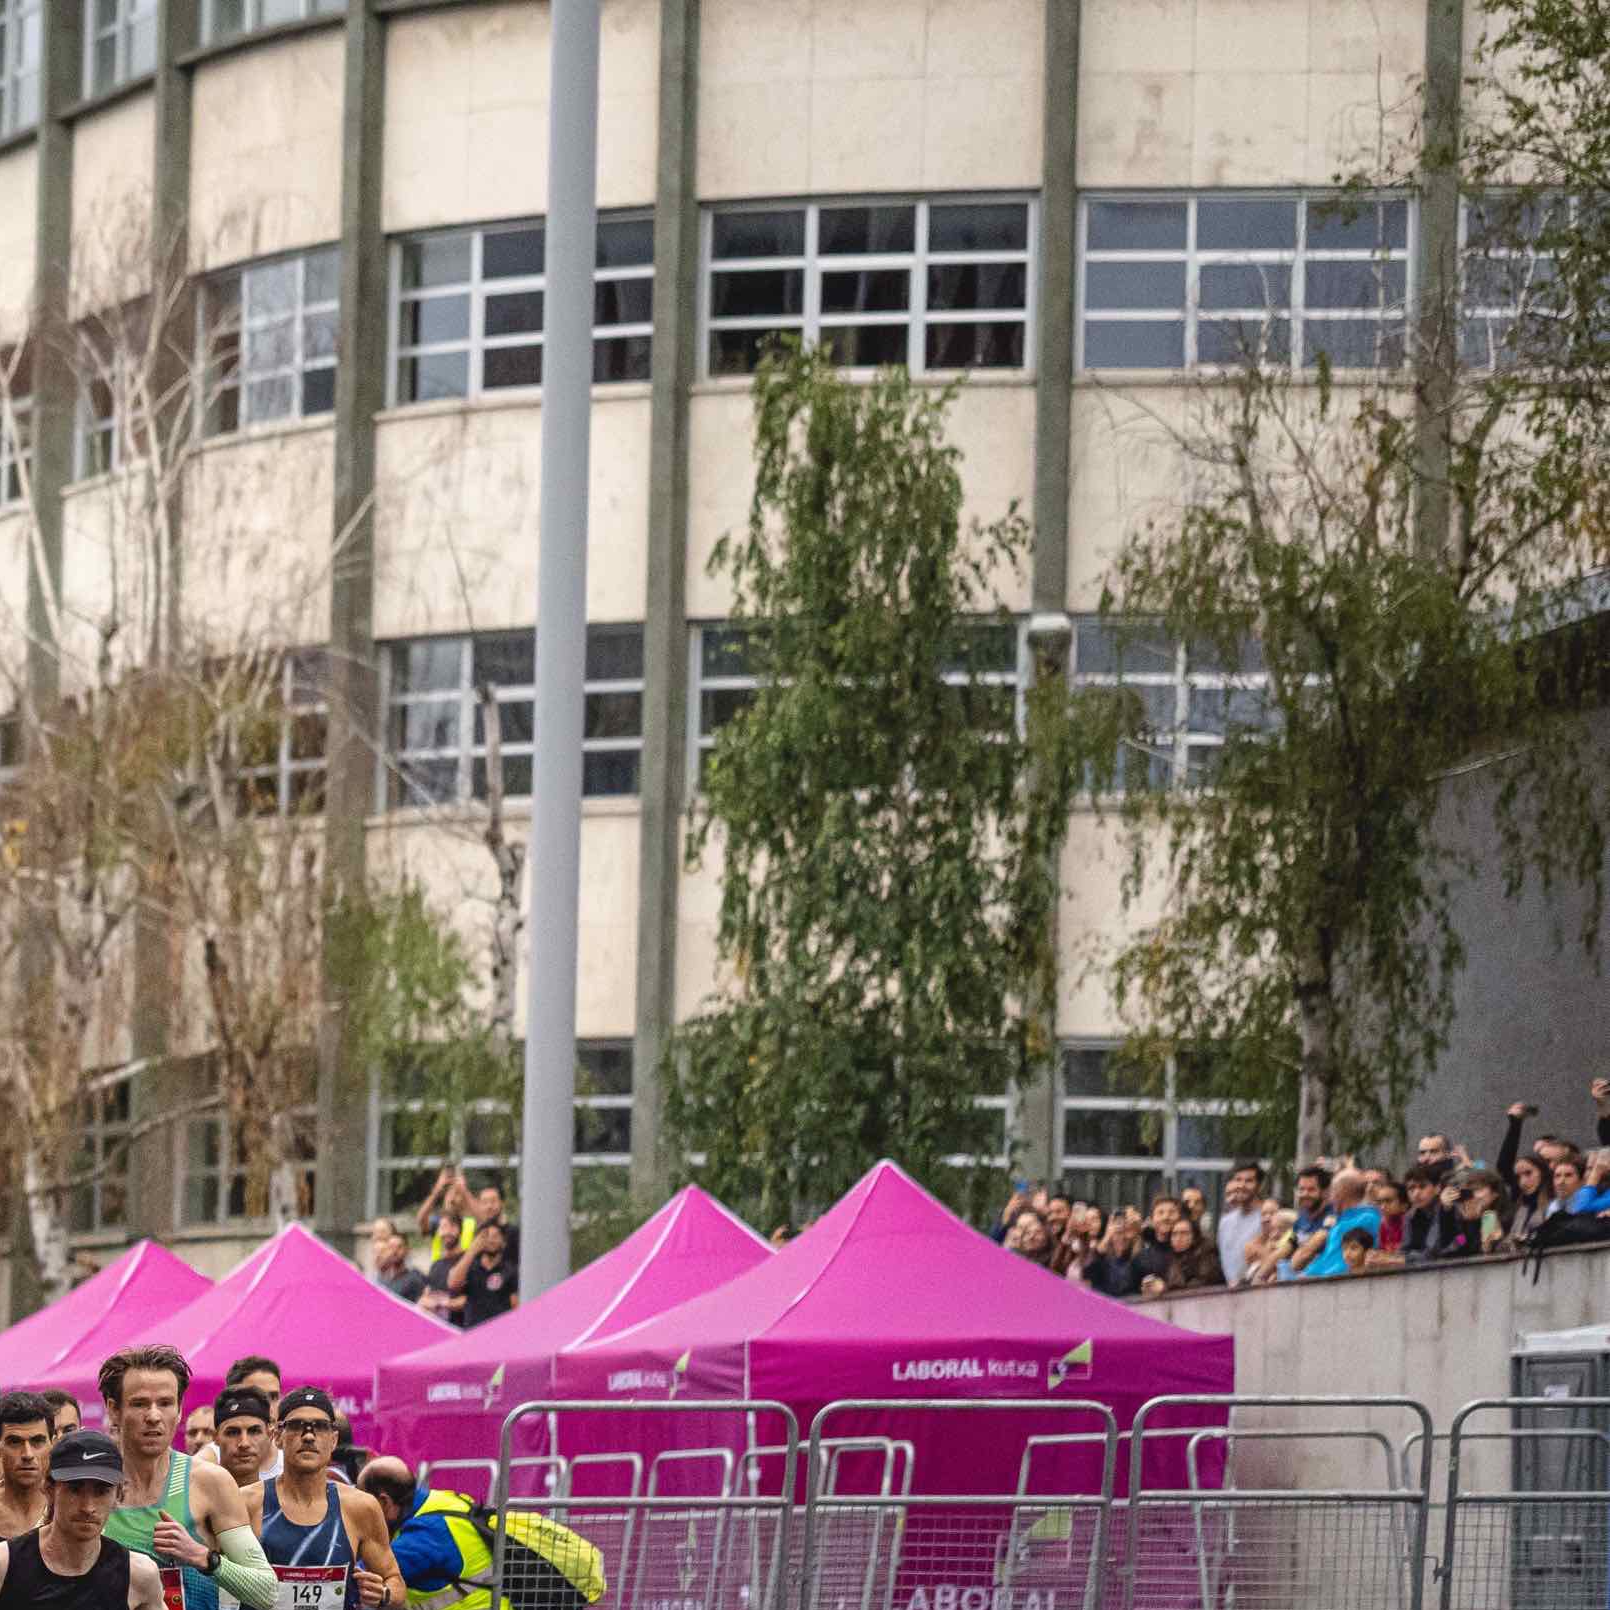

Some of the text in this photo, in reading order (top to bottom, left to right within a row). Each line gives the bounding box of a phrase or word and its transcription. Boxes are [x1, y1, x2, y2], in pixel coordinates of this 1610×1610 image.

[892, 1358, 1039, 1381] LABORAL kutxa
[292, 1585, 323, 1604] 149
